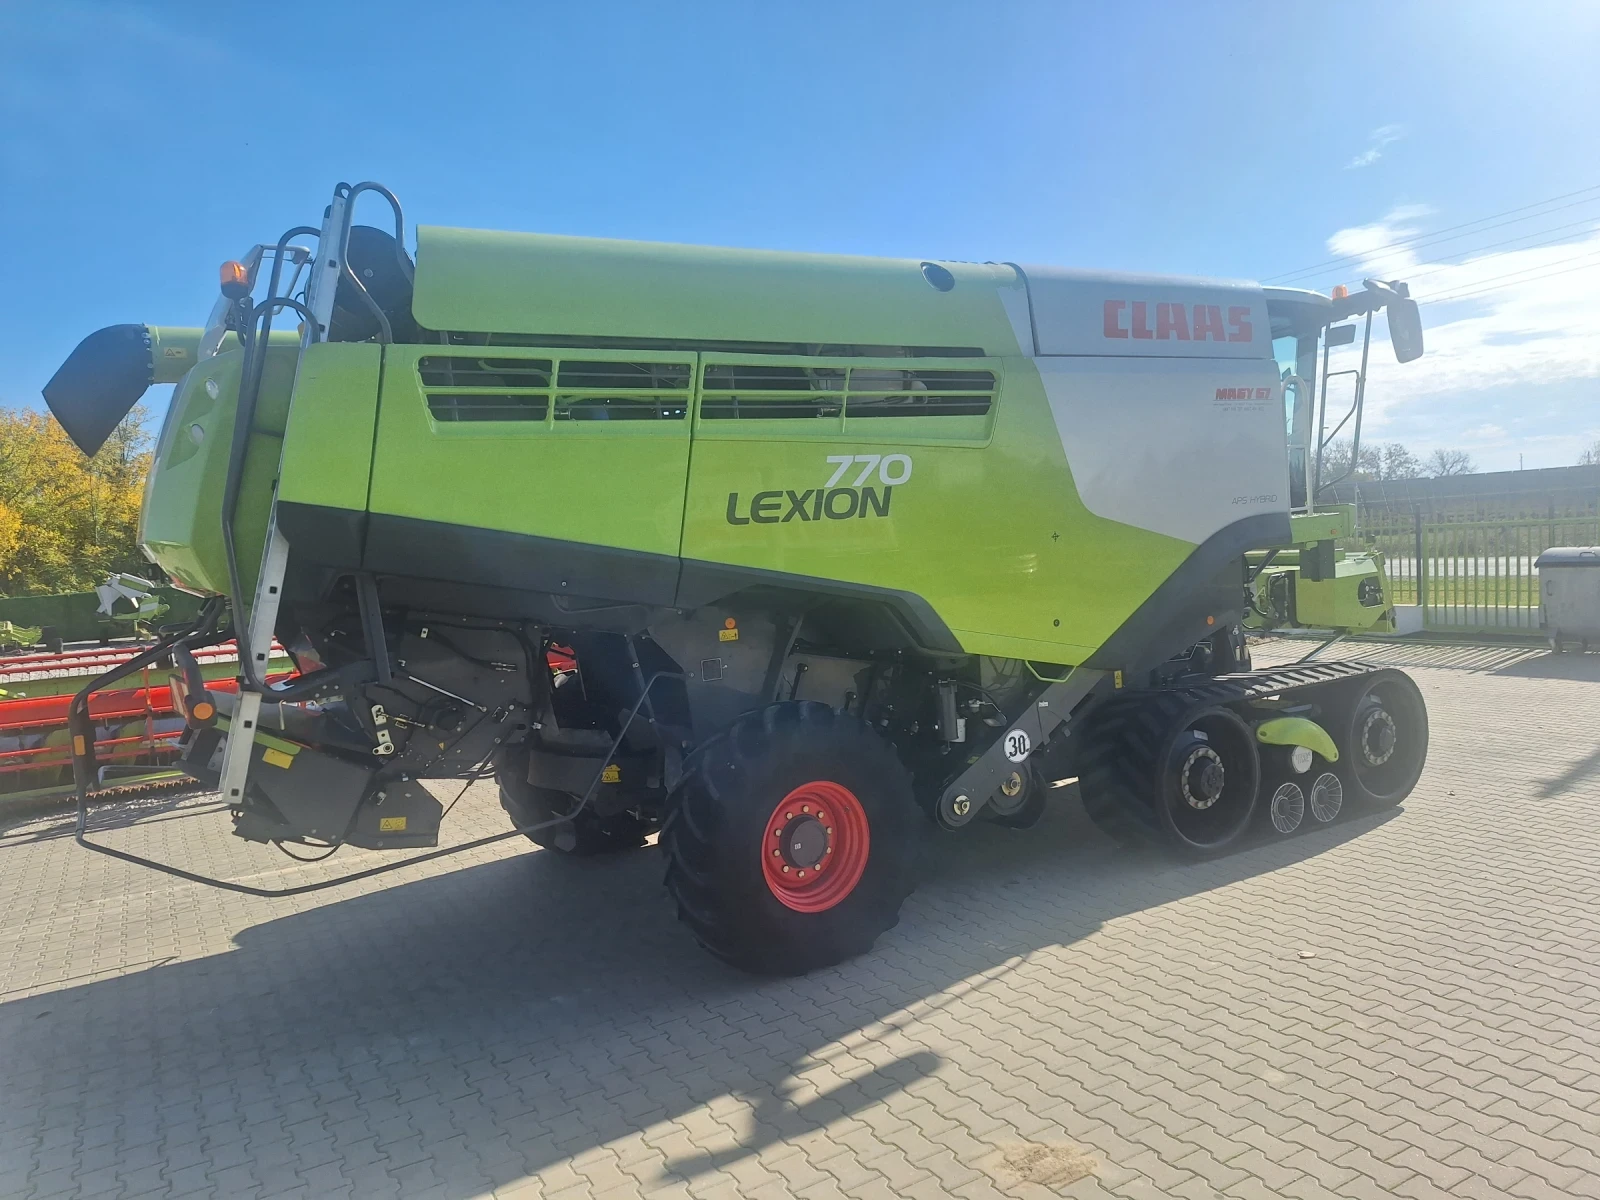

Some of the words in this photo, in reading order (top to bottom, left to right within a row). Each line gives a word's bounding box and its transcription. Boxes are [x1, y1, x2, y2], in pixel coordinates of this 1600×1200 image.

[1103, 300, 1253, 343] CLAAS
[824, 453, 913, 488] 770
[726, 486, 892, 525] LEXION
[1231, 496, 1248, 505] APS
[1249, 494, 1278, 504] HYBRID
[1008, 734, 1026, 757] 30
